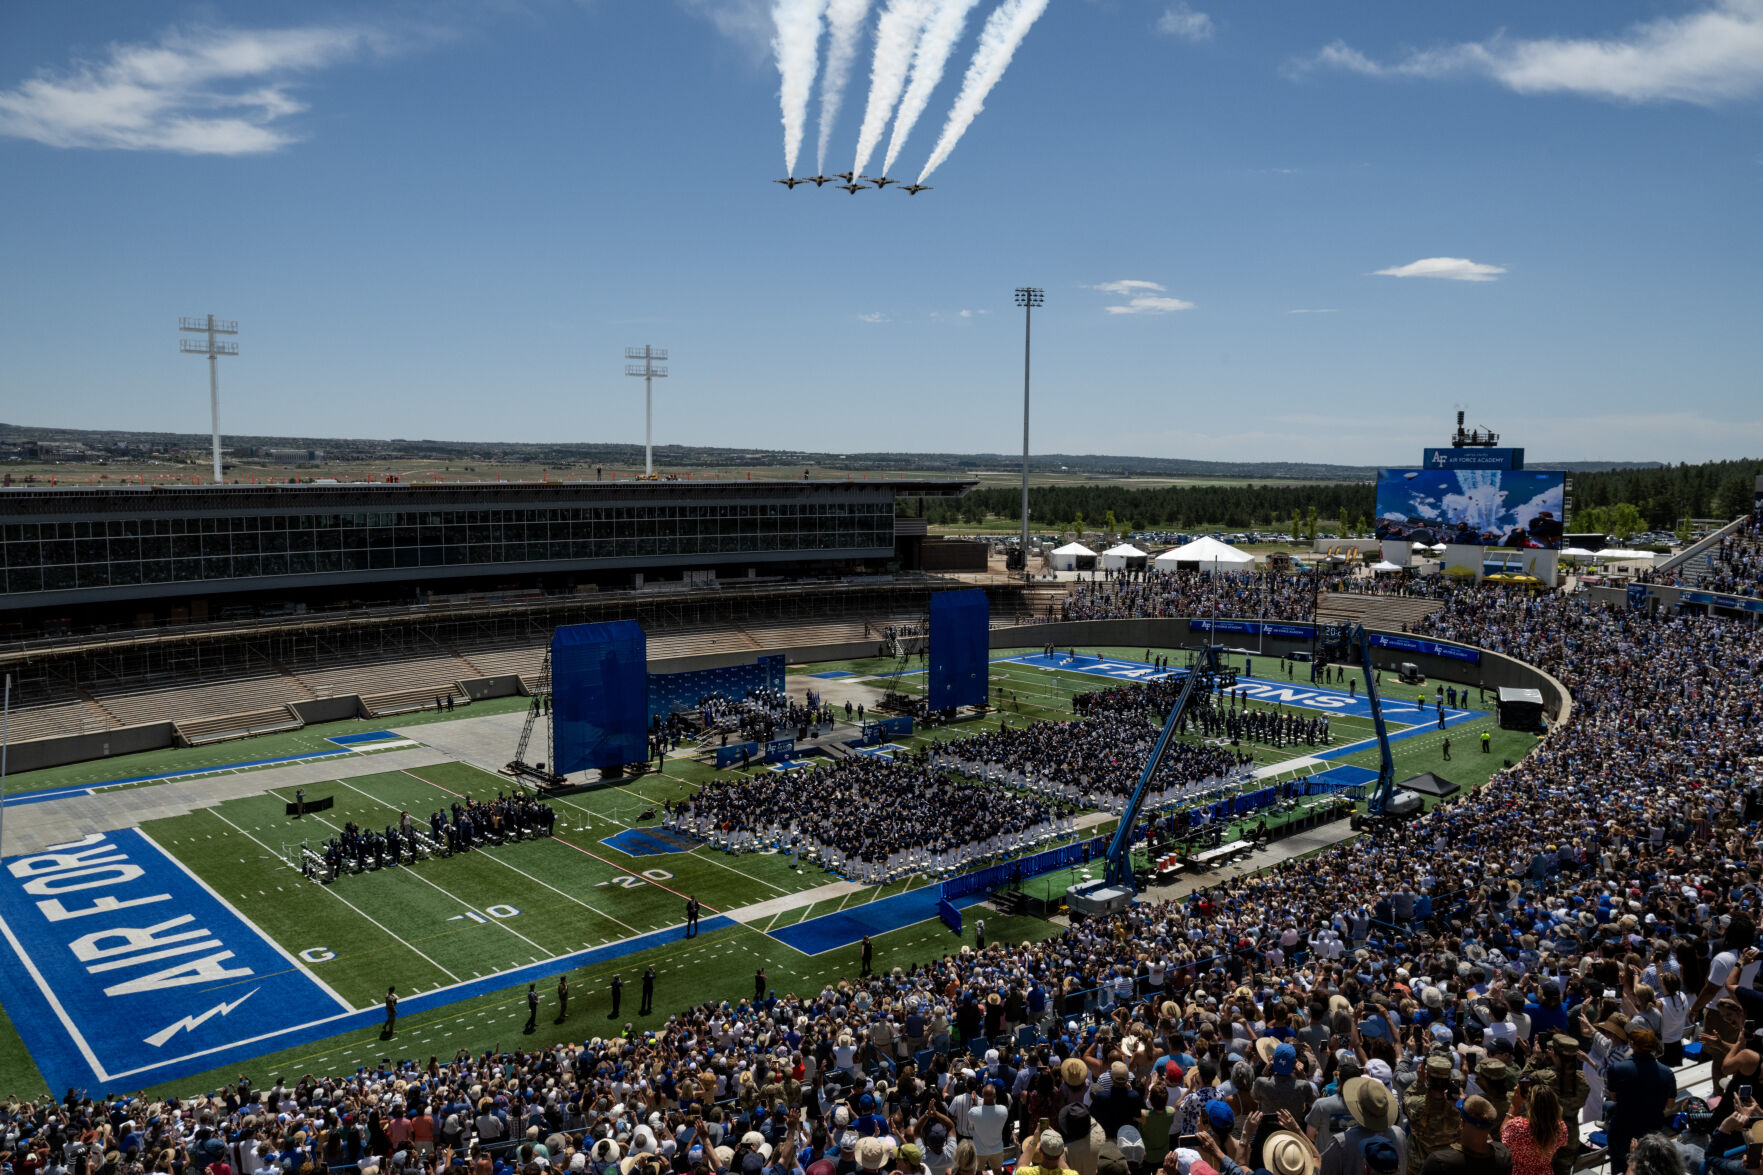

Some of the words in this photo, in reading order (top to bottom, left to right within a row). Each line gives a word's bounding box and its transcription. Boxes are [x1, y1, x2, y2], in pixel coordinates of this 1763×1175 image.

[1432, 450, 1447, 467] AF
[612, 869, 675, 888] 20
[464, 904, 521, 923] 10
[68, 913, 255, 997] AIR
[299, 946, 338, 963] G
